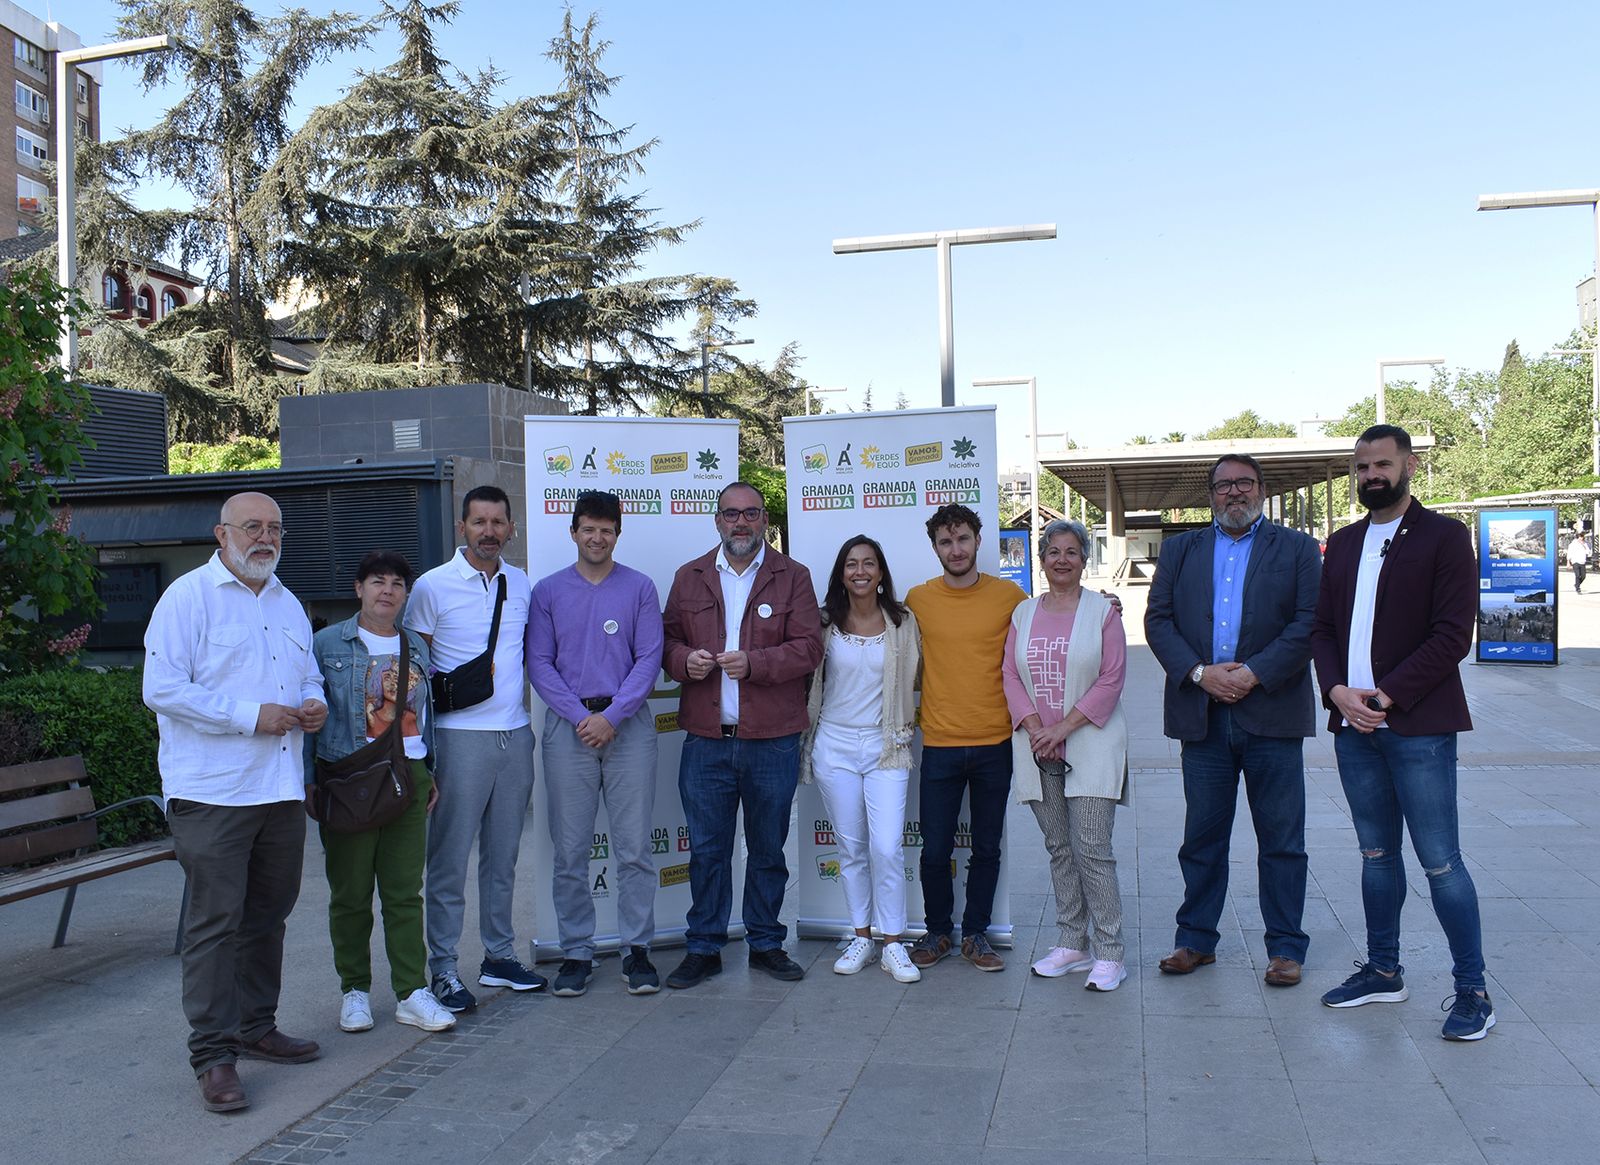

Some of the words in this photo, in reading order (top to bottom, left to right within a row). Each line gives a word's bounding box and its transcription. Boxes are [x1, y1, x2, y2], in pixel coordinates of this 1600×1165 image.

[870, 453, 900, 461] VERDES
[908, 453, 939, 463] Granada
[654, 463, 684, 471] Granada
[863, 481, 916, 494] GRANADA
[925, 478, 980, 491] GRANADA
[670, 489, 720, 500] GRANADA
[802, 484, 854, 497] GRANADA
[805, 497, 852, 509] UNIDA
[866, 495, 914, 506] UNIDA
[928, 491, 978, 504] UNIDA
[547, 502, 576, 512] UNI
[622, 502, 660, 512] NIDA
